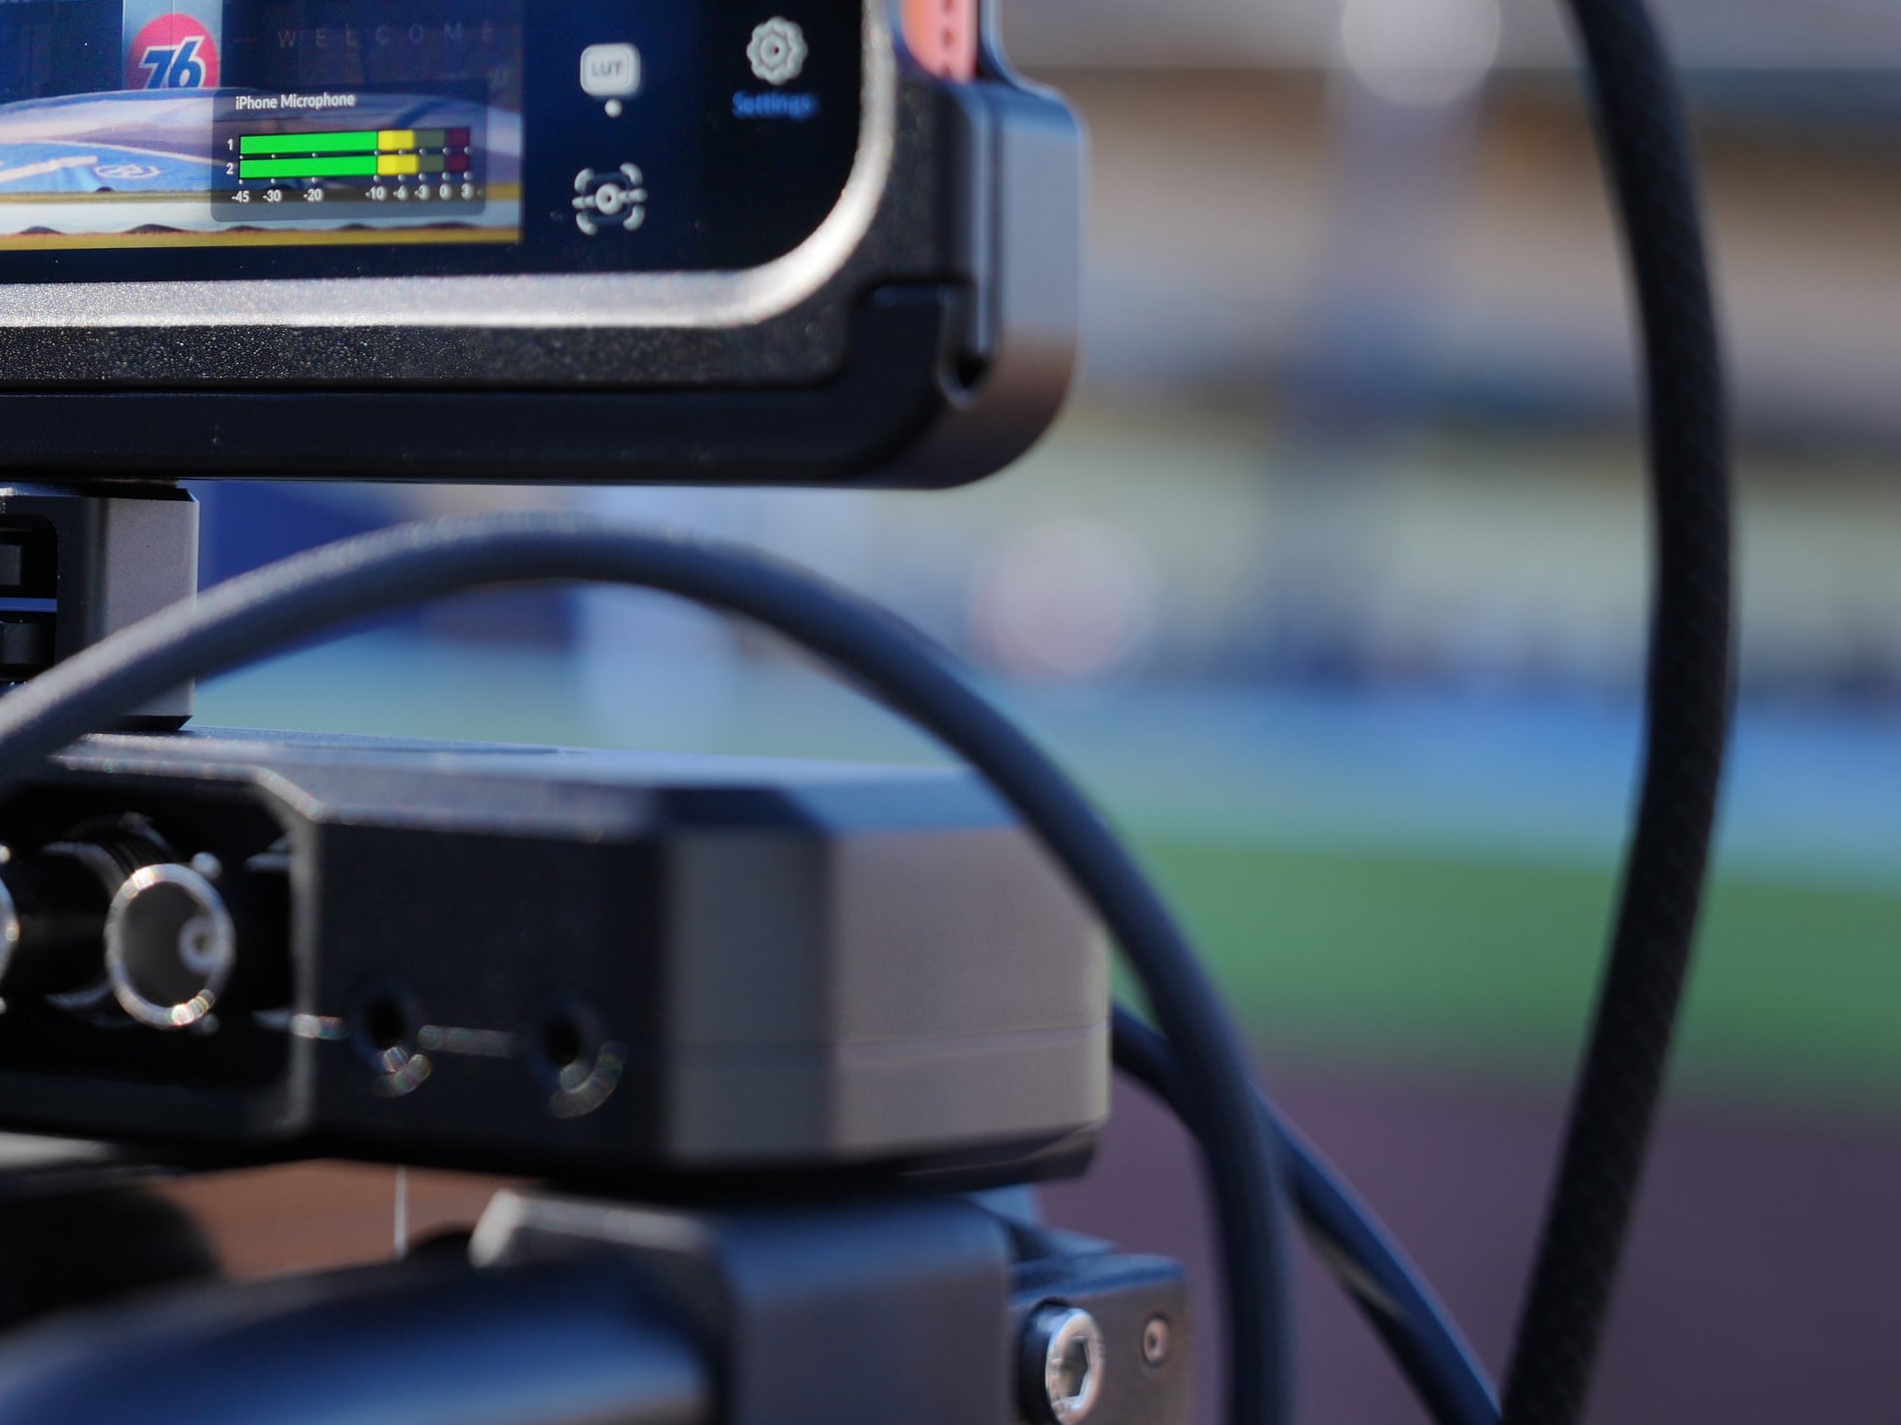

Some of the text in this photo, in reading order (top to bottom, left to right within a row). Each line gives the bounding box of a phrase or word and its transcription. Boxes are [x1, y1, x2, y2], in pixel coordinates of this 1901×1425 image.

[277, 20, 495, 49] WELCOME
[138, 35, 207, 90] 76
[591, 61, 623, 76] LUT
[235, 92, 357, 111] iPhone Microphone
[731, 90, 820, 122] Settings
[227, 138, 235, 151] 1
[226, 162, 235, 175] 2
[231, 191, 250, 203] -45
[262, 189, 282, 203] -30
[303, 187, 324, 202] -20
[365, 184, 386, 200] -10
[414, 183, 431, 200] -3
[439, 182, 452, 199] 0
